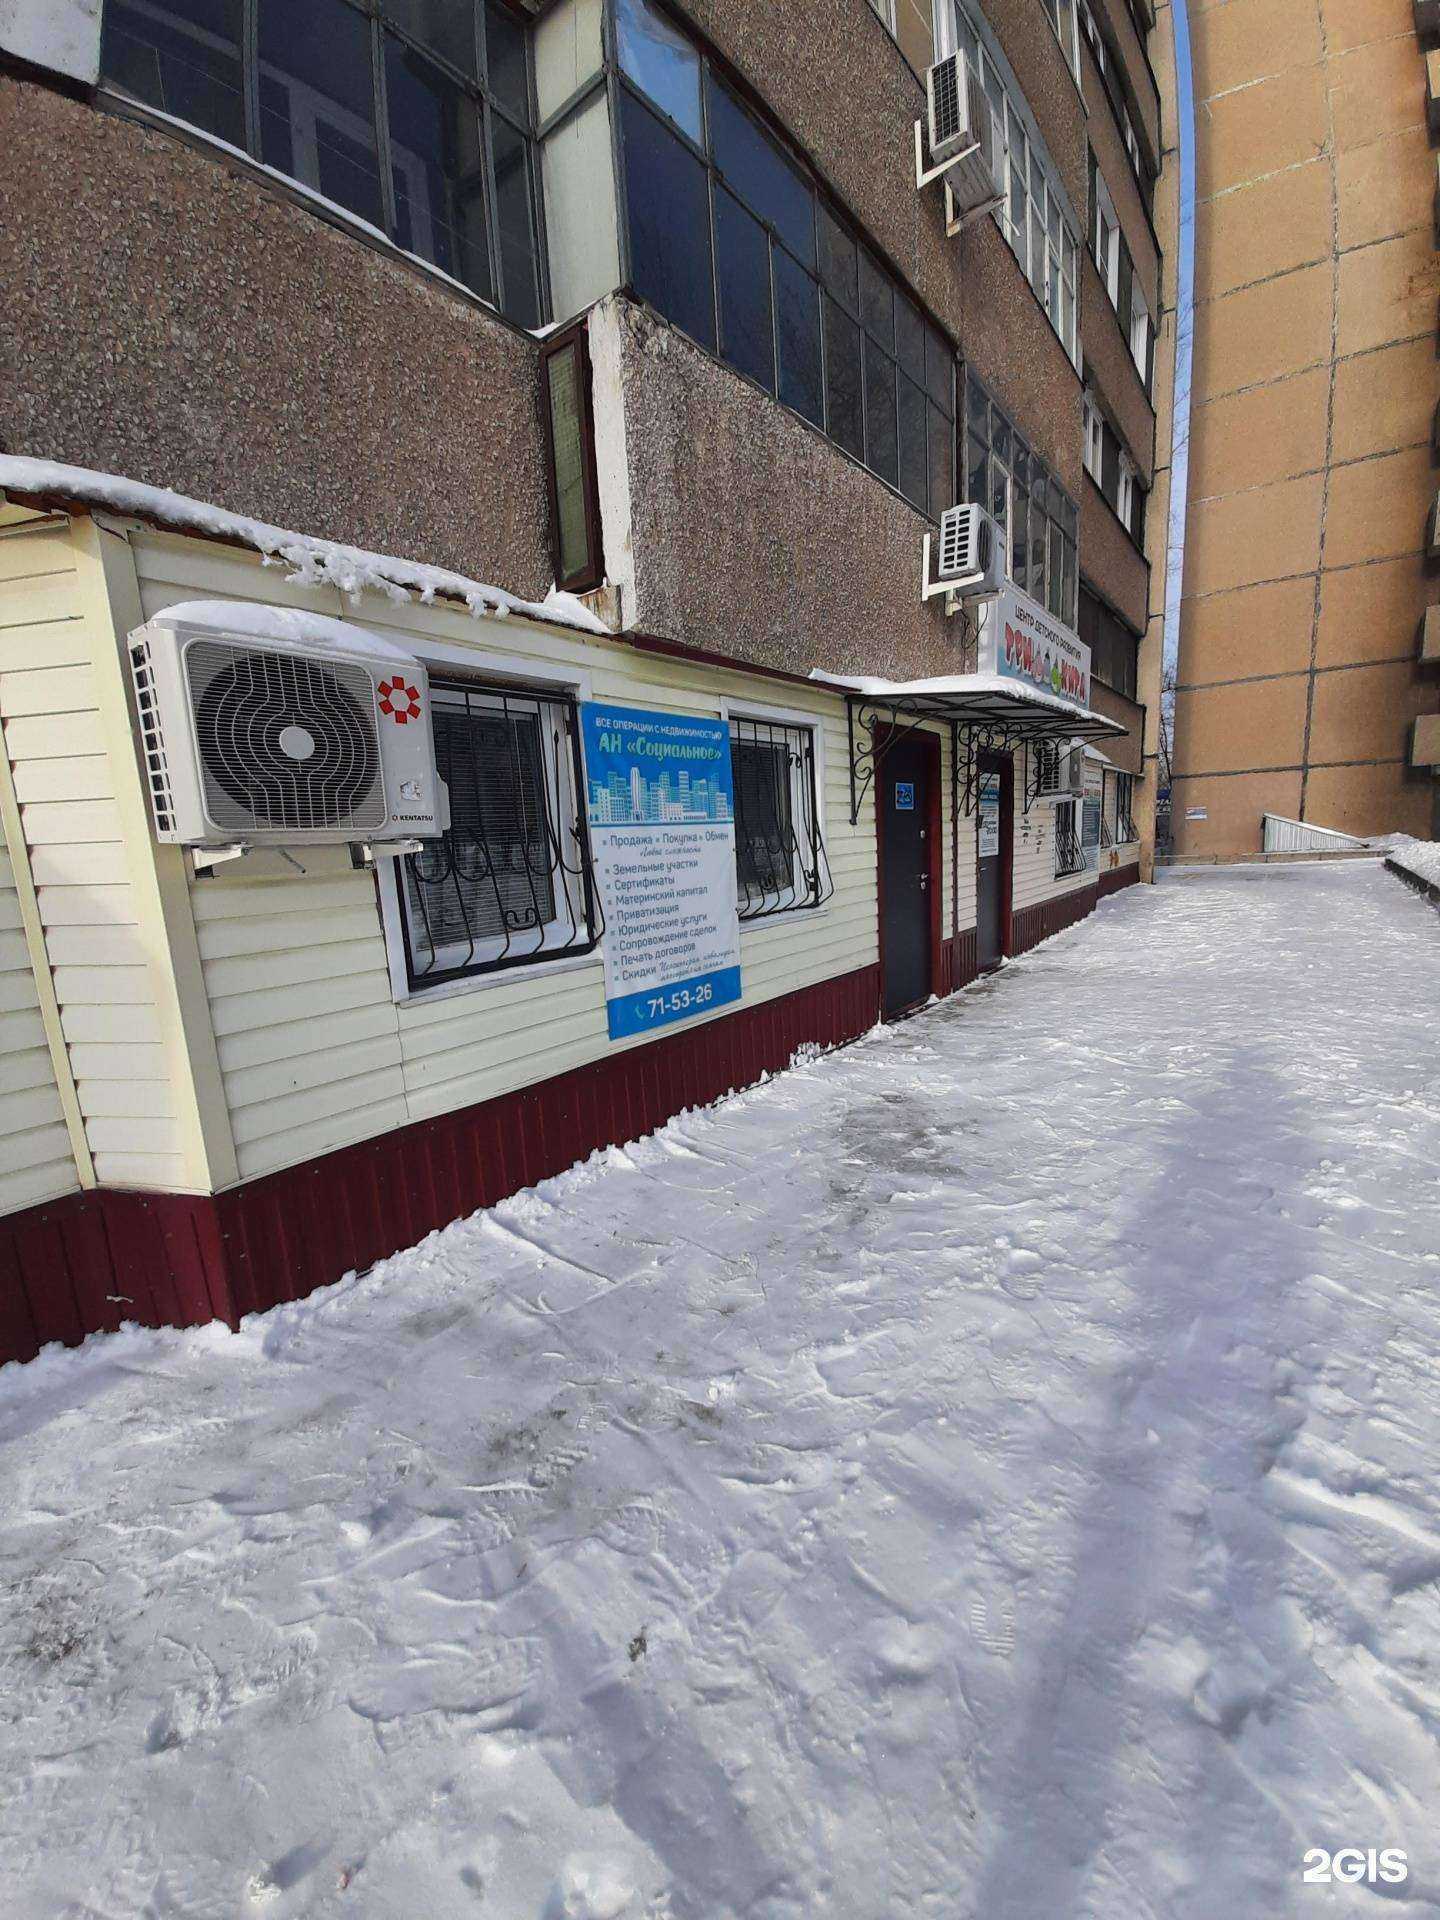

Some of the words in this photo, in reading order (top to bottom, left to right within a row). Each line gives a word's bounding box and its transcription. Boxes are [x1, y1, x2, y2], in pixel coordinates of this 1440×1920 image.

[1015, 604, 1034, 627] ЦЕНТР
[595, 717, 612, 729] ВСЕ
[612, 719, 654, 734] ОПЕРАЦИИ
[661, 726, 723, 740] НЕДВИЖИМОСТЬЮ
[599, 732, 622, 754] АН
[610, 834, 653, 848] Продажа
[662, 832, 697, 845] Покупка
[705, 831, 729, 841] Обмен
[612, 863, 665, 876] Земельные
[666, 860, 699, 873] участки
[614, 877, 675, 893] Сертификаты
[615, 892, 675, 907] Материнский
[676, 885, 708, 898] капитал
[616, 904, 680, 922] Приватизация
[618, 917, 679, 939] Юридические
[680, 913, 708, 928] услуги
[619, 931, 688, 953] Сопровождение
[689, 926, 717, 939] сделок
[620, 951, 653, 966] Печать
[654, 942, 696, 960] договоров
[622, 966, 657, 981] Скидки
[647, 983, 713, 1018] 71-53-26
